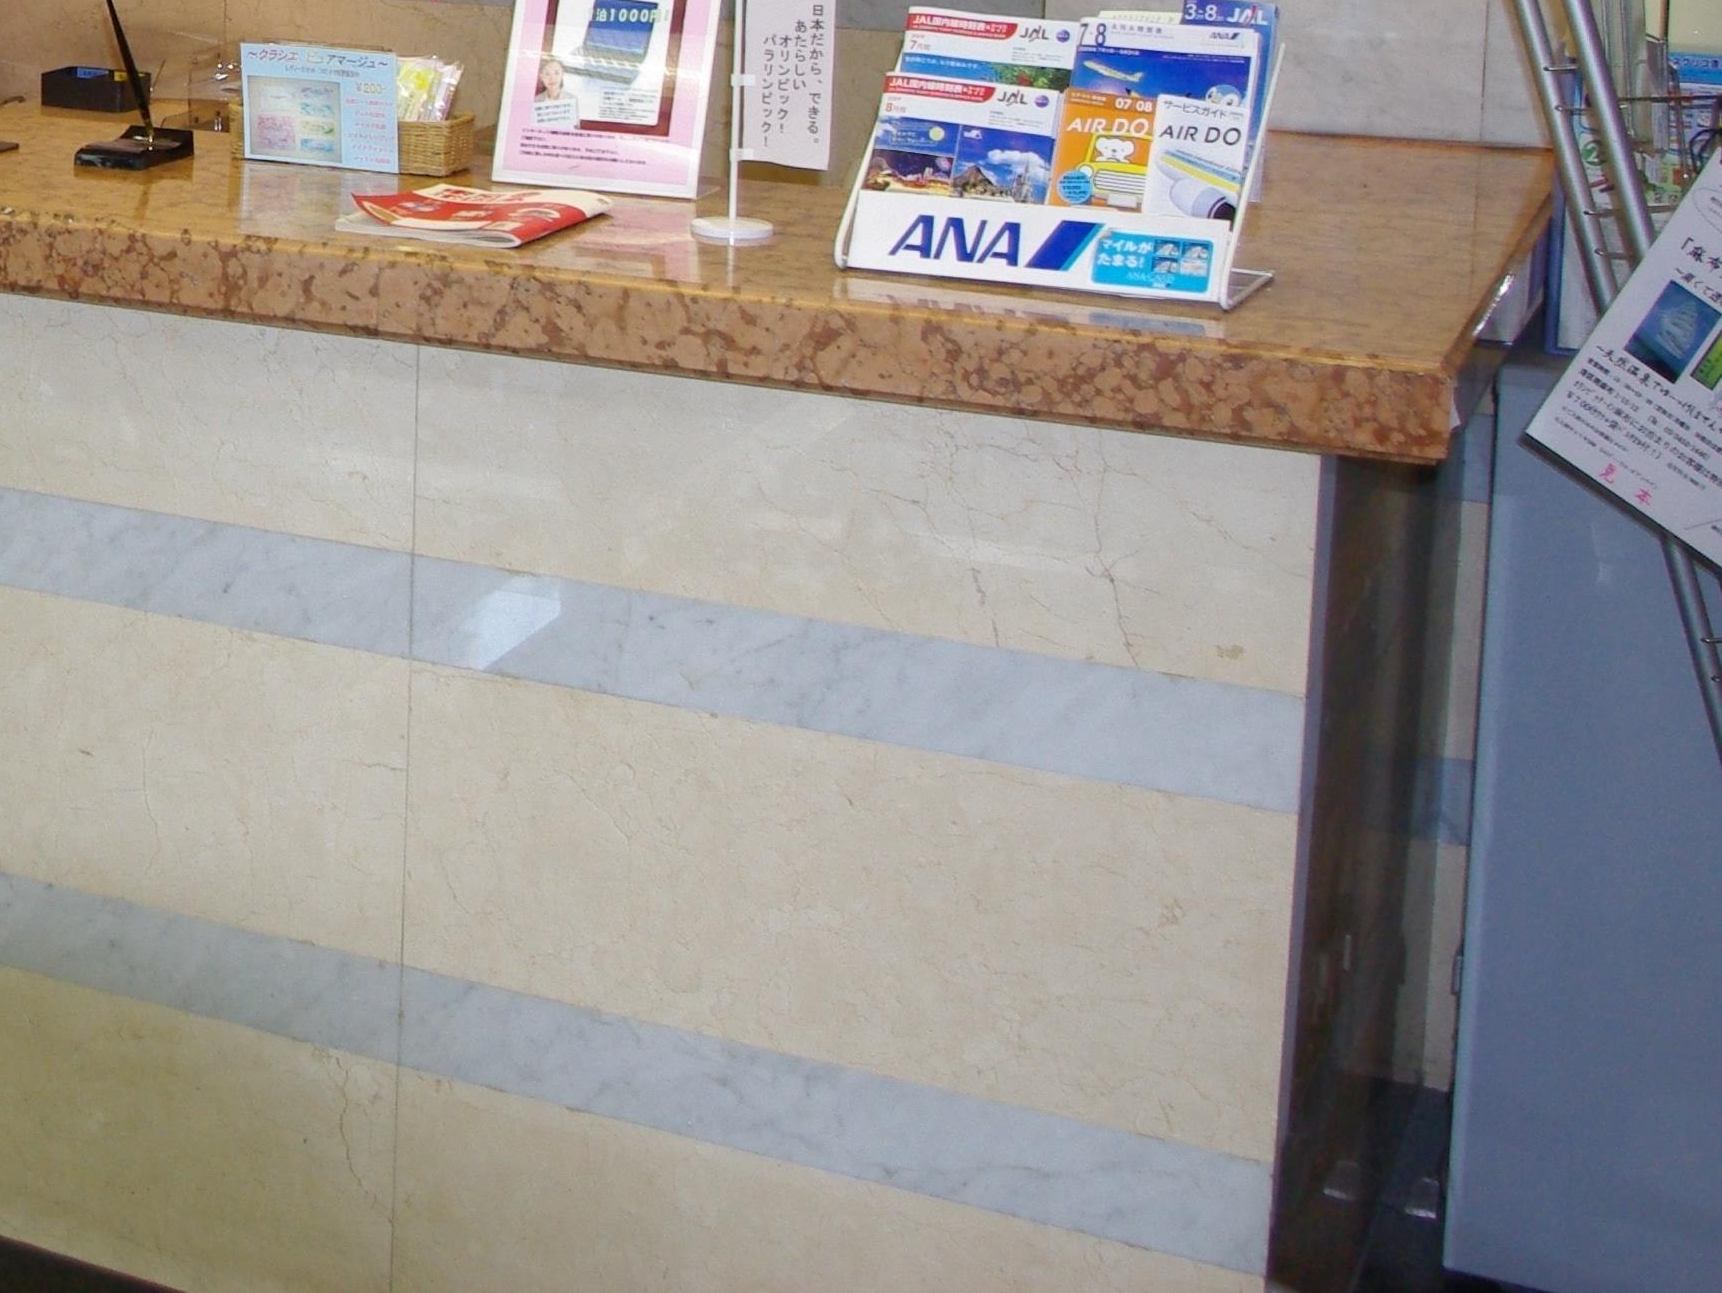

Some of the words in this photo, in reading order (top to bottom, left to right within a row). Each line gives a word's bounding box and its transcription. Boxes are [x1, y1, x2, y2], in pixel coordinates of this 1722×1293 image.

[1226, 4, 1269, 26] JAL
[1019, 25, 1050, 42] JAL
[793, 19, 808, 91] あたらしい
[997, 88, 1028, 106] JAL
[1163, 99, 1227, 120] サービスガイド
[1066, 117, 1107, 134] AIR
[1112, 118, 1149, 137] DO
[1159, 124, 1199, 143] AIR
[1204, 126, 1242, 146] DO
[889, 213, 1021, 268] ANA
[1101, 239, 1154, 255] マイルが
